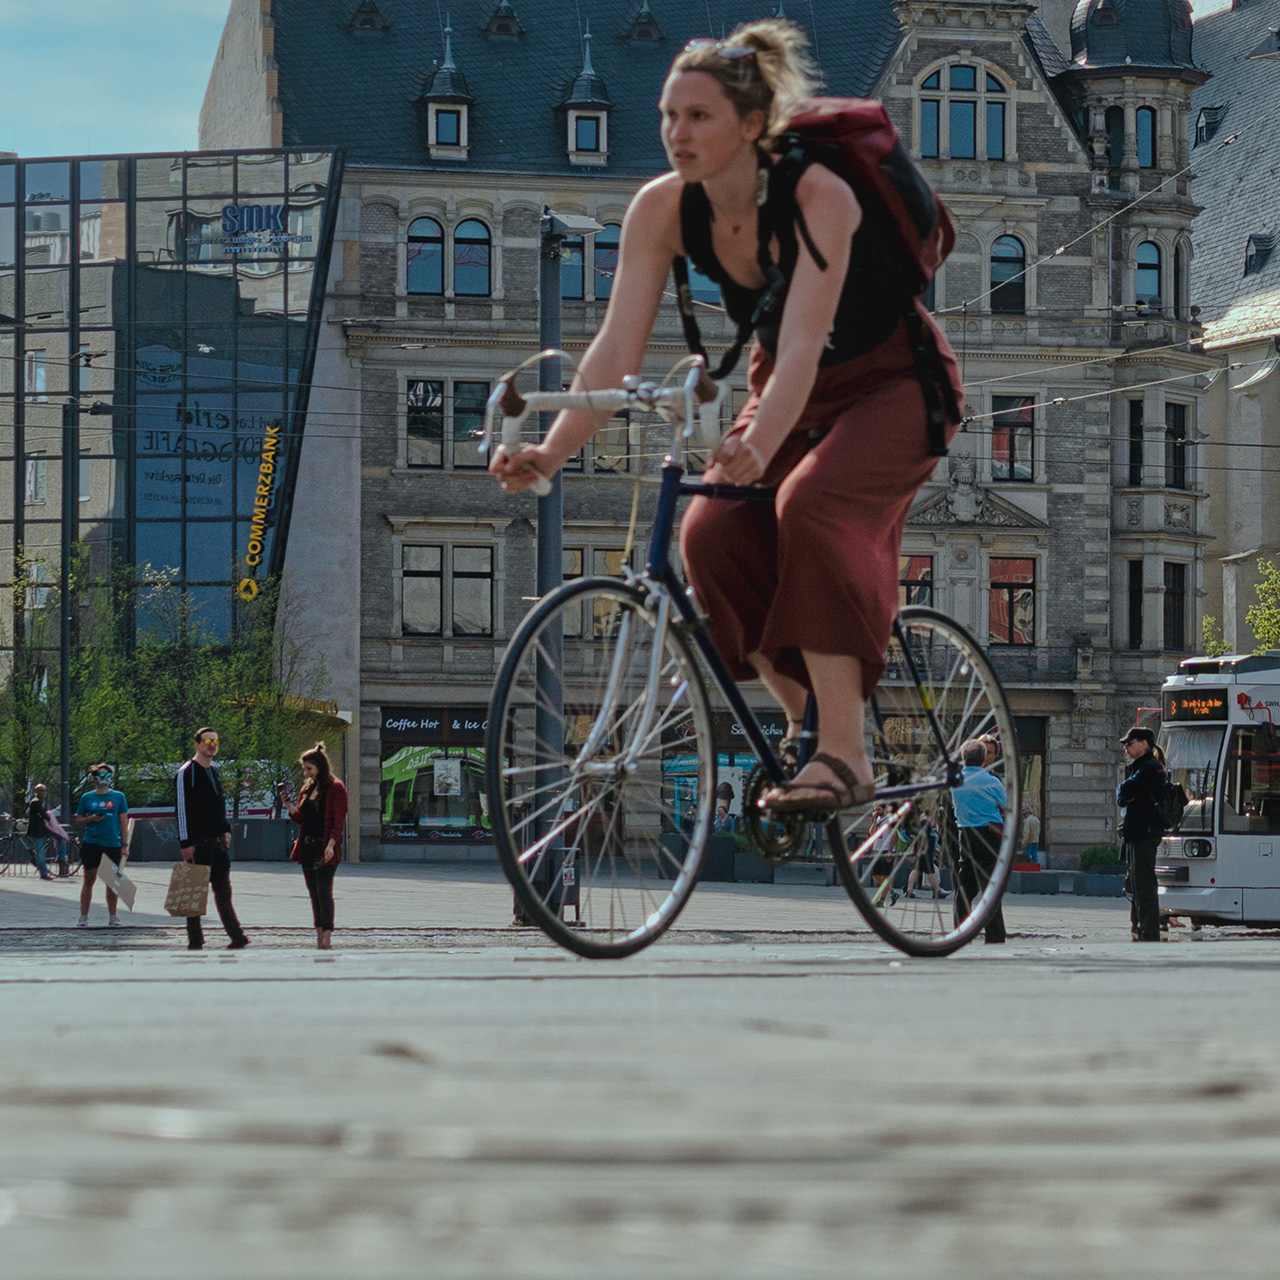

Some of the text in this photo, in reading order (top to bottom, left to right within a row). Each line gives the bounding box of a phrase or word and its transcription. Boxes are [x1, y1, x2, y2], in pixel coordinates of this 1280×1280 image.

[221, 204, 284, 233] SMK
[245, 425, 280, 566] COMMERZBANK
[1265, 700, 1280, 708] SWH.
[386, 719, 418, 730] Coffee
[420, 719, 440, 729] Hot
[452, 720, 460, 729] &
[464, 721, 480, 729] Ice
